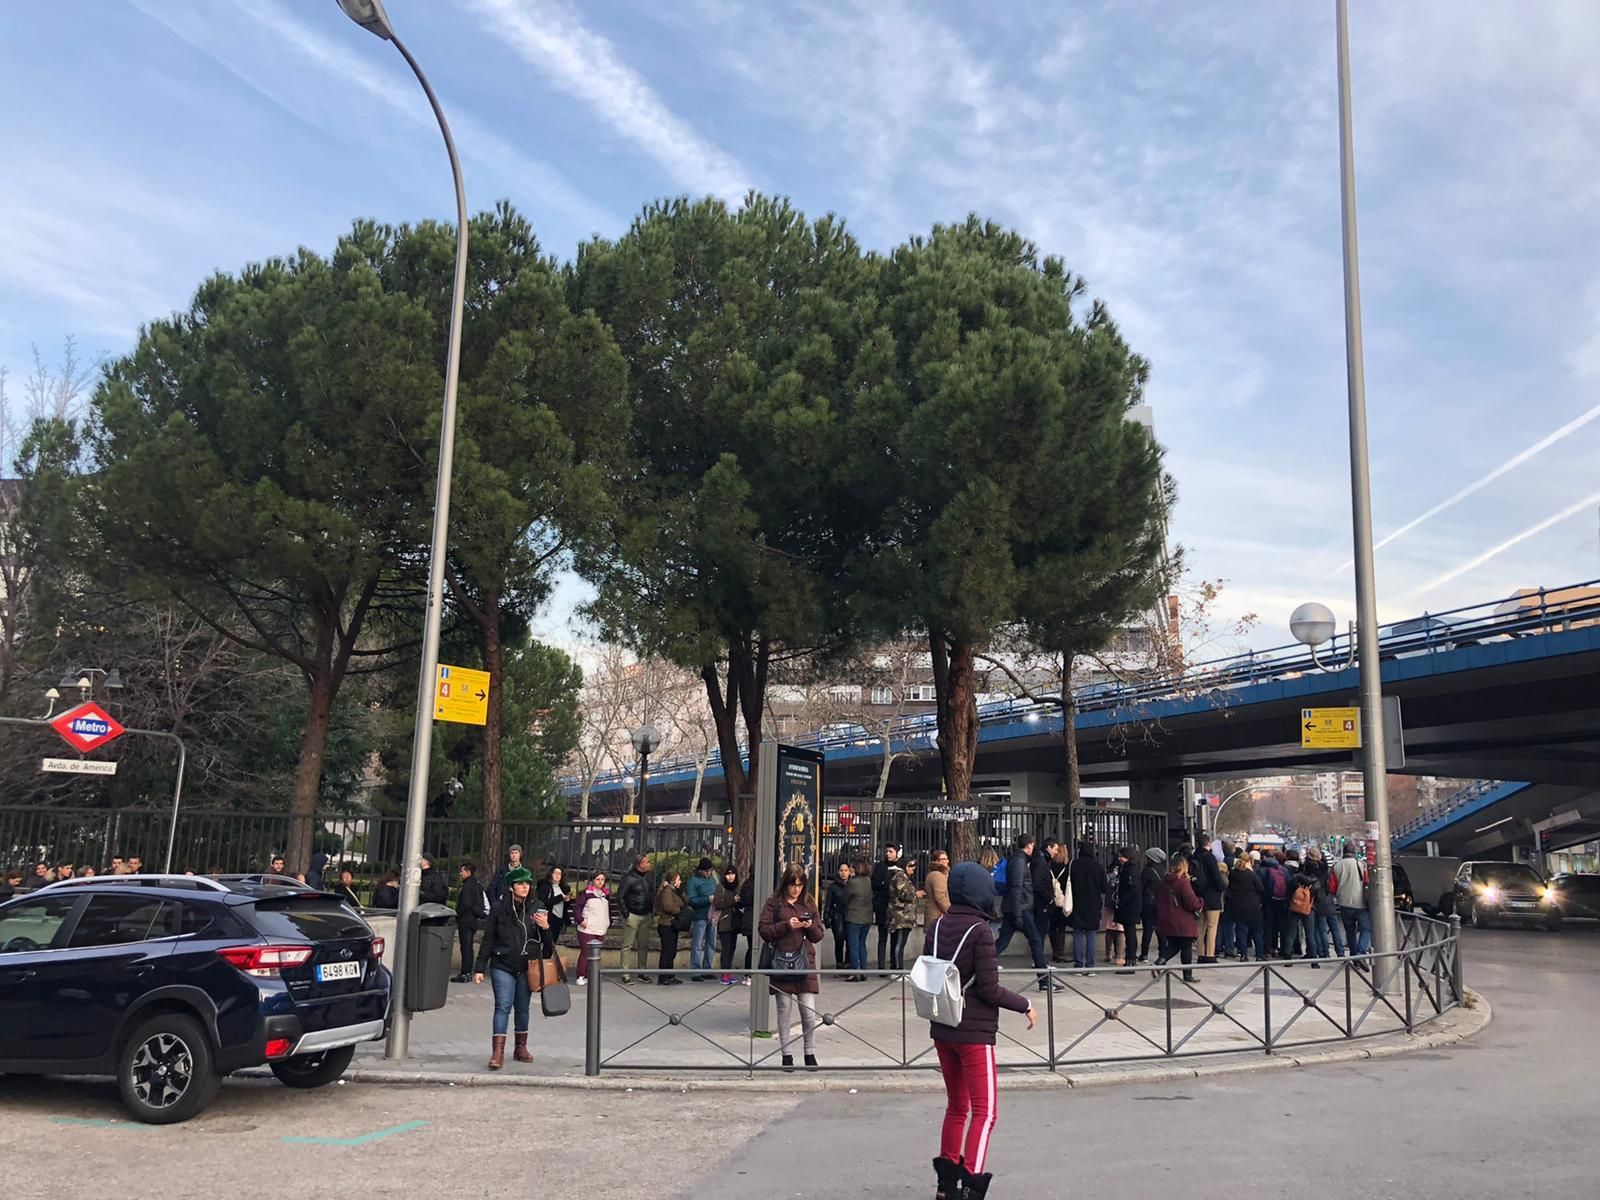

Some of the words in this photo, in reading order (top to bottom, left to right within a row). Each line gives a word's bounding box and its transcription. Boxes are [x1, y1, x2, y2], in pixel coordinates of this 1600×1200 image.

[442, 684, 448, 696] 4
[75, 720, 107, 734] Metro
[1346, 720, 1352, 730] 4
[48, 761, 69, 771] Avda.
[70, 762, 80, 770] de
[323, 965, 343, 979] 6498
